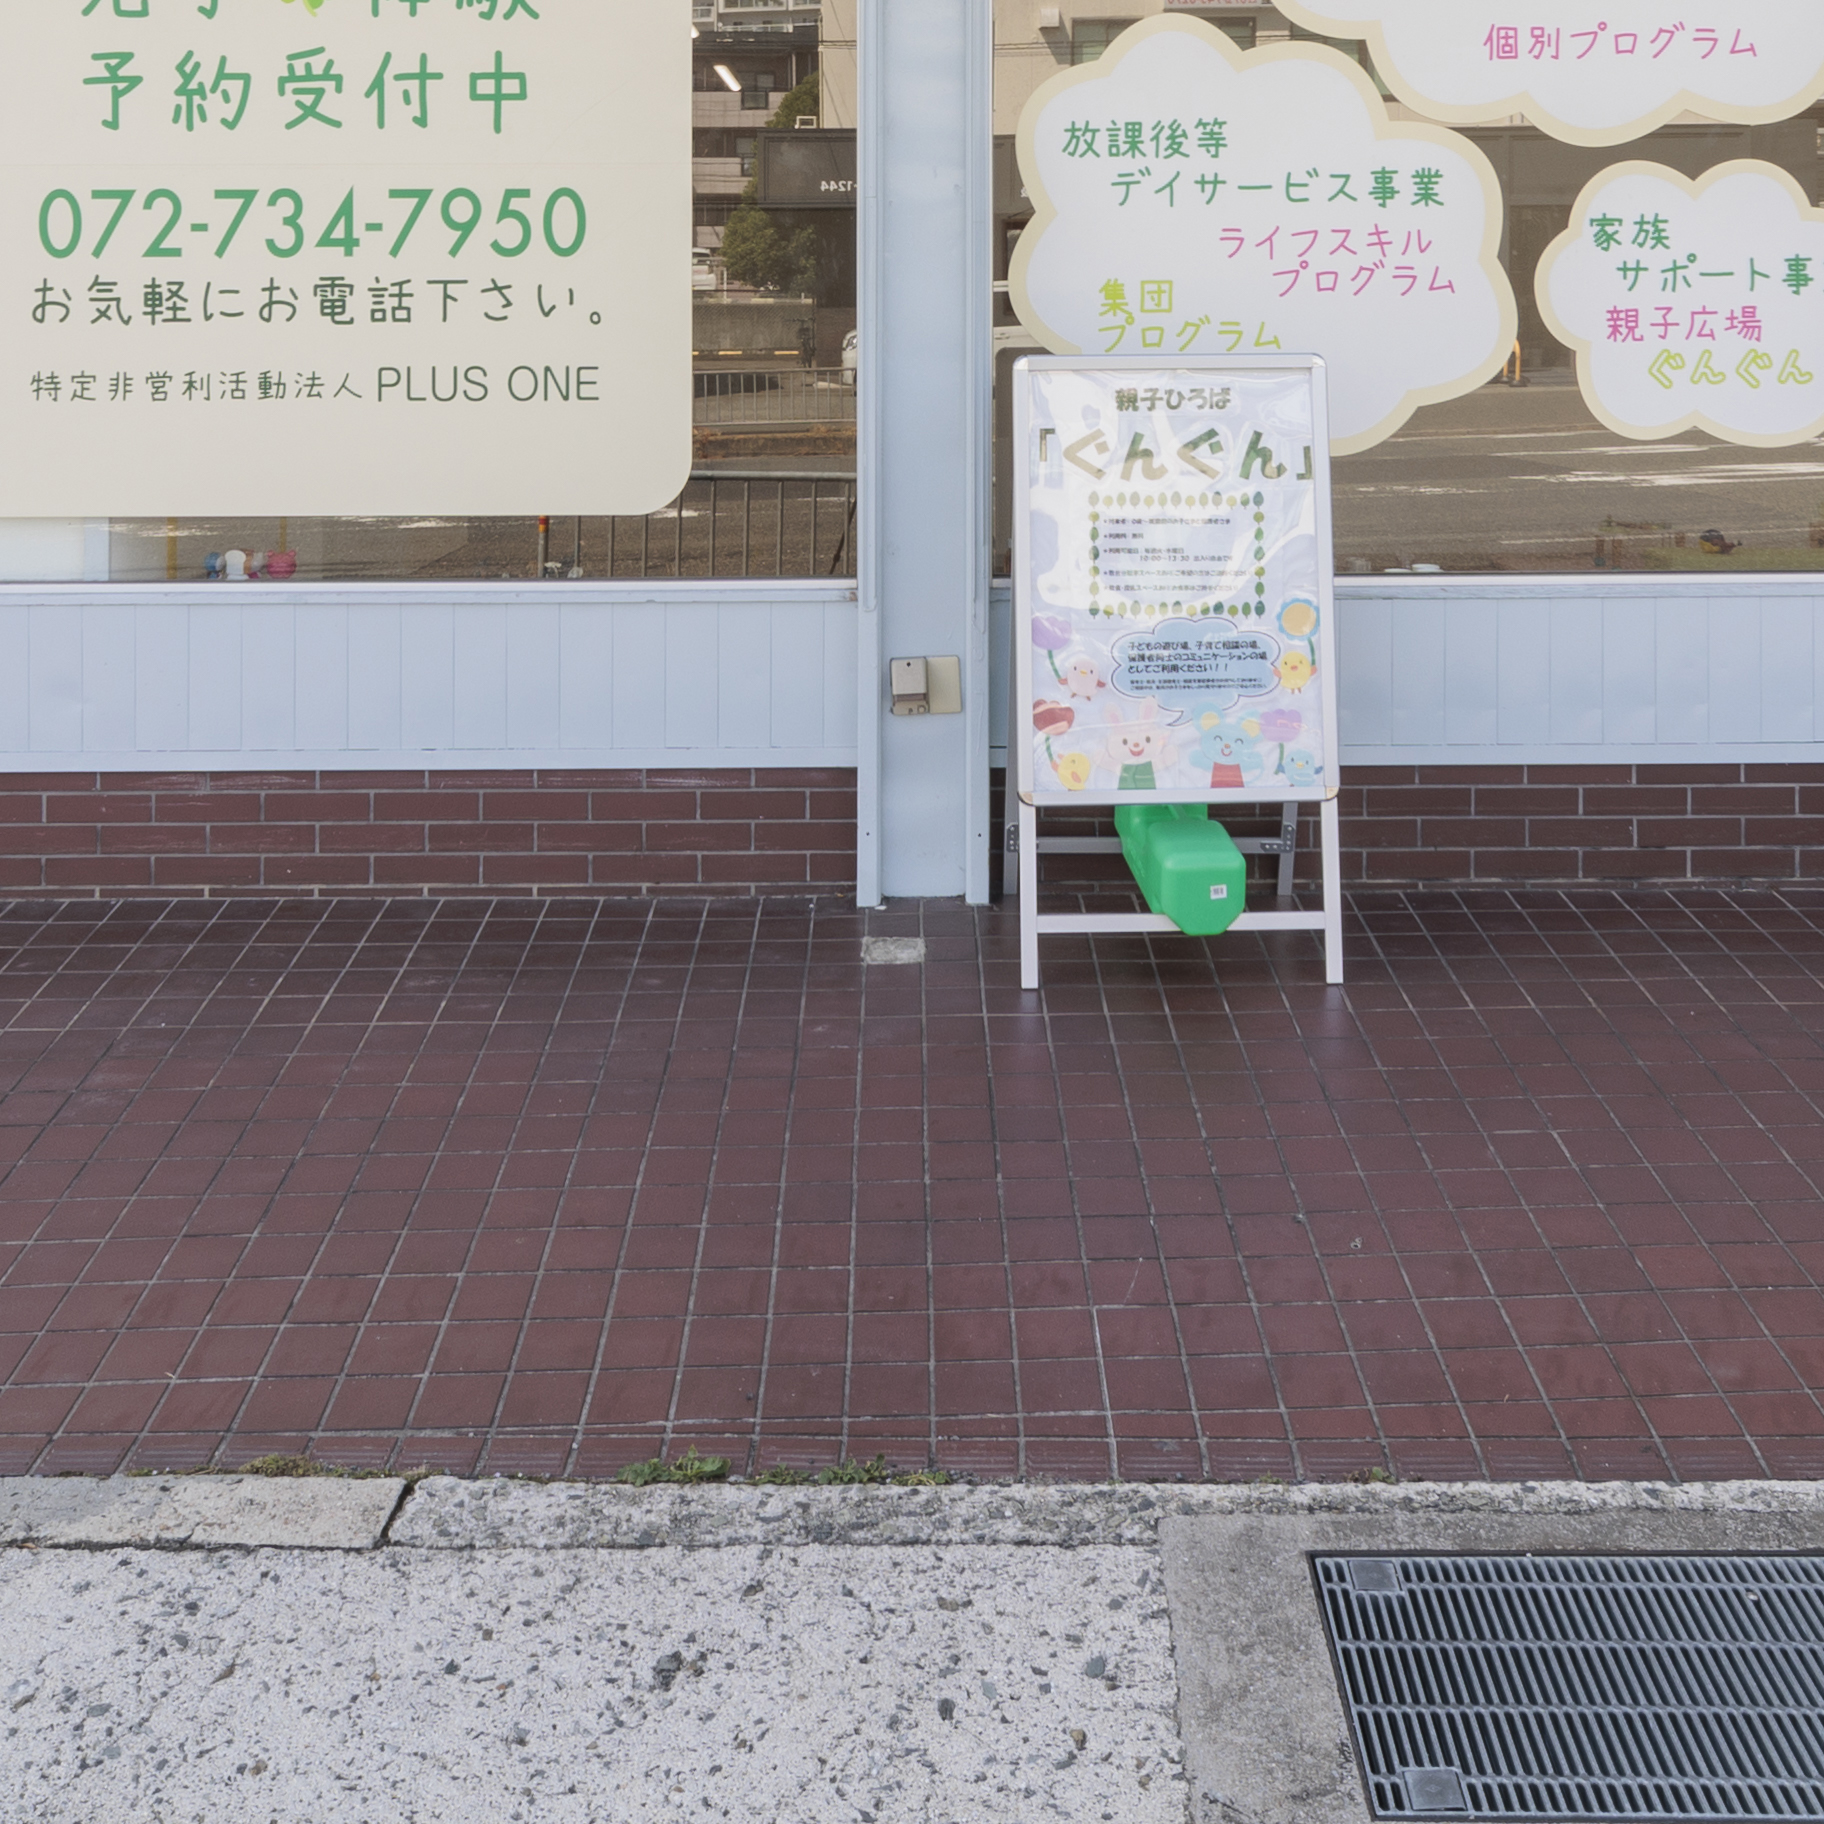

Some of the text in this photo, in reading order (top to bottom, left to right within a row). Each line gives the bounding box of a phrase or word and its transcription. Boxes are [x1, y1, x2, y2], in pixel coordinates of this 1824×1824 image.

[1482, 22, 1759, 63] 個別プログラム
[81, 47, 528, 134] 予約受付中
[1061, 118, 1230, 160] 放課後等
[1110, 167, 1446, 209] デイサービス事業
[38, 185, 587, 259] 072-734-7950
[1218, 222, 1433, 260] ライフスキル
[1589, 214, 1671, 252] 家族
[1098, 279, 1174, 316] 集団
[1271, 262, 1457, 298] プログラム
[31, 275, 602, 327] お気軽にお電話下さい。
[1096, 318, 1284, 354] プログラム
[1604, 305, 1764, 344] 親子広場
[30, 365, 600, 402] 特定非営利活動法人 PLUS ONE
[1646, 348, 1813, 388] ぐんぐん
[1114, 386, 1232, 413] 親子ひろば
